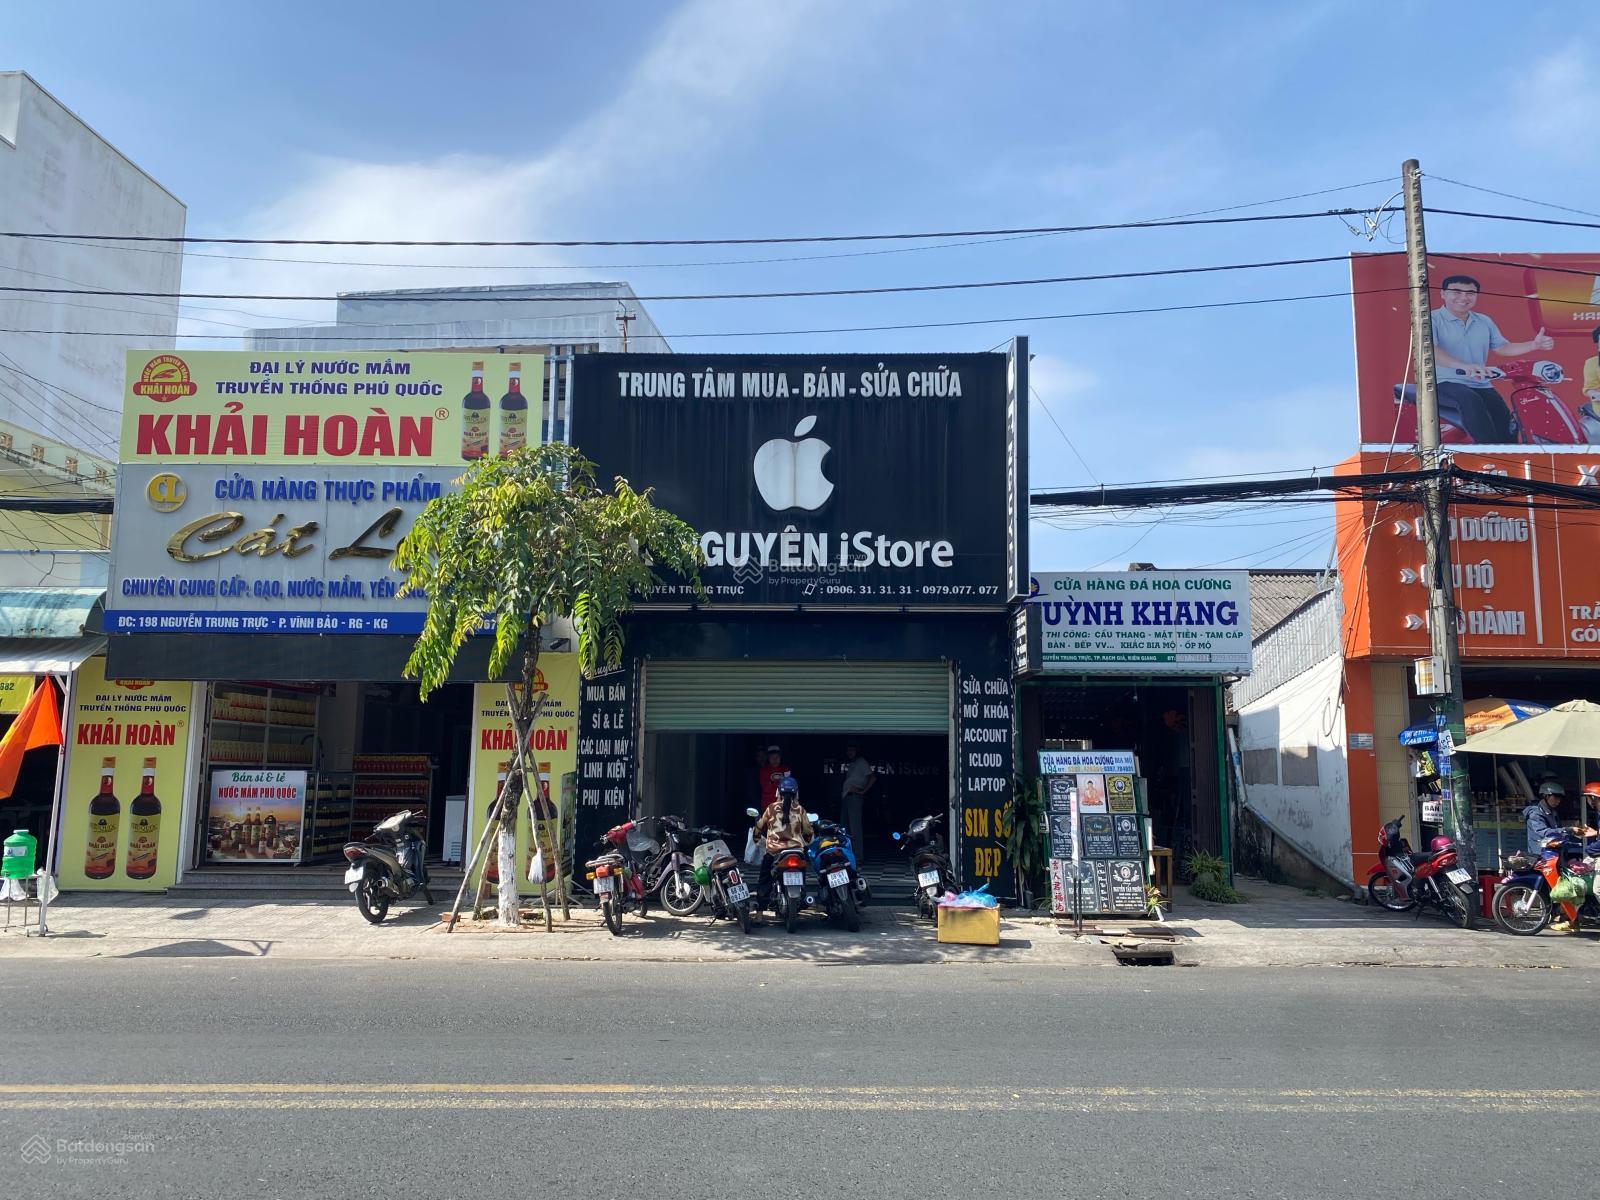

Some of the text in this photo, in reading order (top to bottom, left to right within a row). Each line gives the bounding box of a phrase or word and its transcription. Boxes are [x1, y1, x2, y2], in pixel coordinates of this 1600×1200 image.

[249, 358, 410, 377] ĐẠI LÝ NƯỚC MẮM
[216, 378, 442, 397] TRUYỀN THỐNG PHÚ QUỐC
[618, 371, 685, 399] TRUNG
[692, 367, 735, 399] TÂM
[907, 365, 962, 398] CHỮA
[136, 401, 433, 457] KHẢI HOÀN
[215, 473, 442, 505] CỬA HÀNG THỰC PHẨM
[1461, 511, 1528, 543] DƯỠNG
[695, 525, 828, 568] GUYÊN
[840, 531, 954, 568] iStore
[1054, 577, 1232, 591] CỬA HÀNG ĐÁ HOA CƯƠNG
[1466, 559, 1494, 593] HỘ
[122, 577, 175, 598] CHUYÊN
[179, 579, 217, 598] CUNG
[220, 574, 250, 598] CẤP:
[253, 579, 283, 600] GẠO,
[287, 577, 326, 598] NƯỚC
[370, 575, 395, 597] YẾN
[826, 585, 856, 594] 0906.
[860, 585, 876, 594] 31.
[879, 585, 896, 594] 31.
[899, 585, 912, 594] 31
[978, 585, 999, 595] 077
[1042, 595, 1239, 626] UỲNH KHANG
[1468, 605, 1525, 635] HÀNH
[118, 612, 388, 631] ĐC: 198 NGUYỄN TRUNG TRỰC P. VĨNH BẢO RG KG
[1063, 630, 1091, 639] CÔNG:
[586, 683, 626, 701] MUA BÁN
[963, 675, 1009, 696] SỬA CHỮA
[603, 713, 610, 729] &
[613, 708, 624, 729] LẺ
[963, 699, 1009, 719] MỞ KHÓA
[77, 717, 175, 746] KHẢI HOÀN
[964, 728, 1008, 743] ACCOUNT
[580, 736, 629, 758] CÁC LOẠI MÁY
[584, 758, 626, 782] LINH KIỆN
[969, 753, 1002, 767] ICLOUD
[232, 772, 253, 783] Bán
[266, 772, 274, 782] &
[968, 777, 1006, 792] LAPTOP
[218, 785, 239, 798] NƯỚC
[582, 786, 625, 809] PHỤ KIỆN
[965, 808, 989, 837] SIM
[975, 848, 1002, 883] ĐẸP
